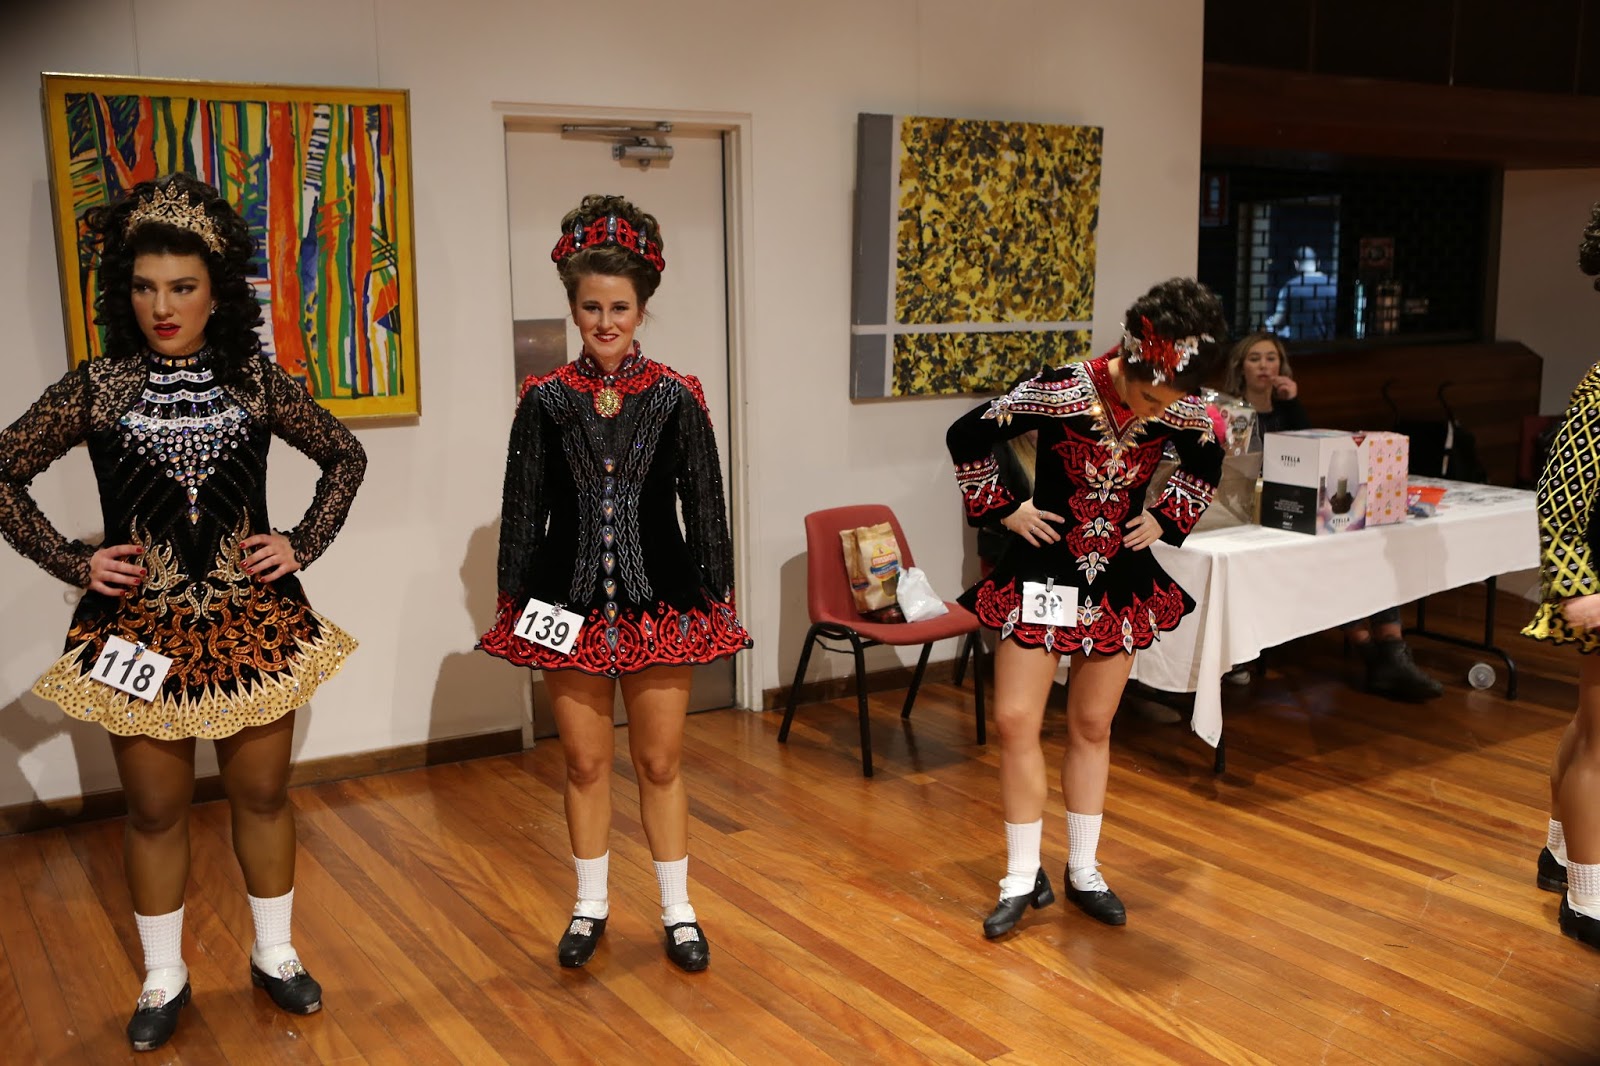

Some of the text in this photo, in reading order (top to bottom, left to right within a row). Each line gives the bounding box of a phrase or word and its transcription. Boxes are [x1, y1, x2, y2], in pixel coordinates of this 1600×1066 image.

[1281, 455, 1300, 463] STELLA
[524, 611, 570, 646] 139
[102, 650, 155, 692] 118
